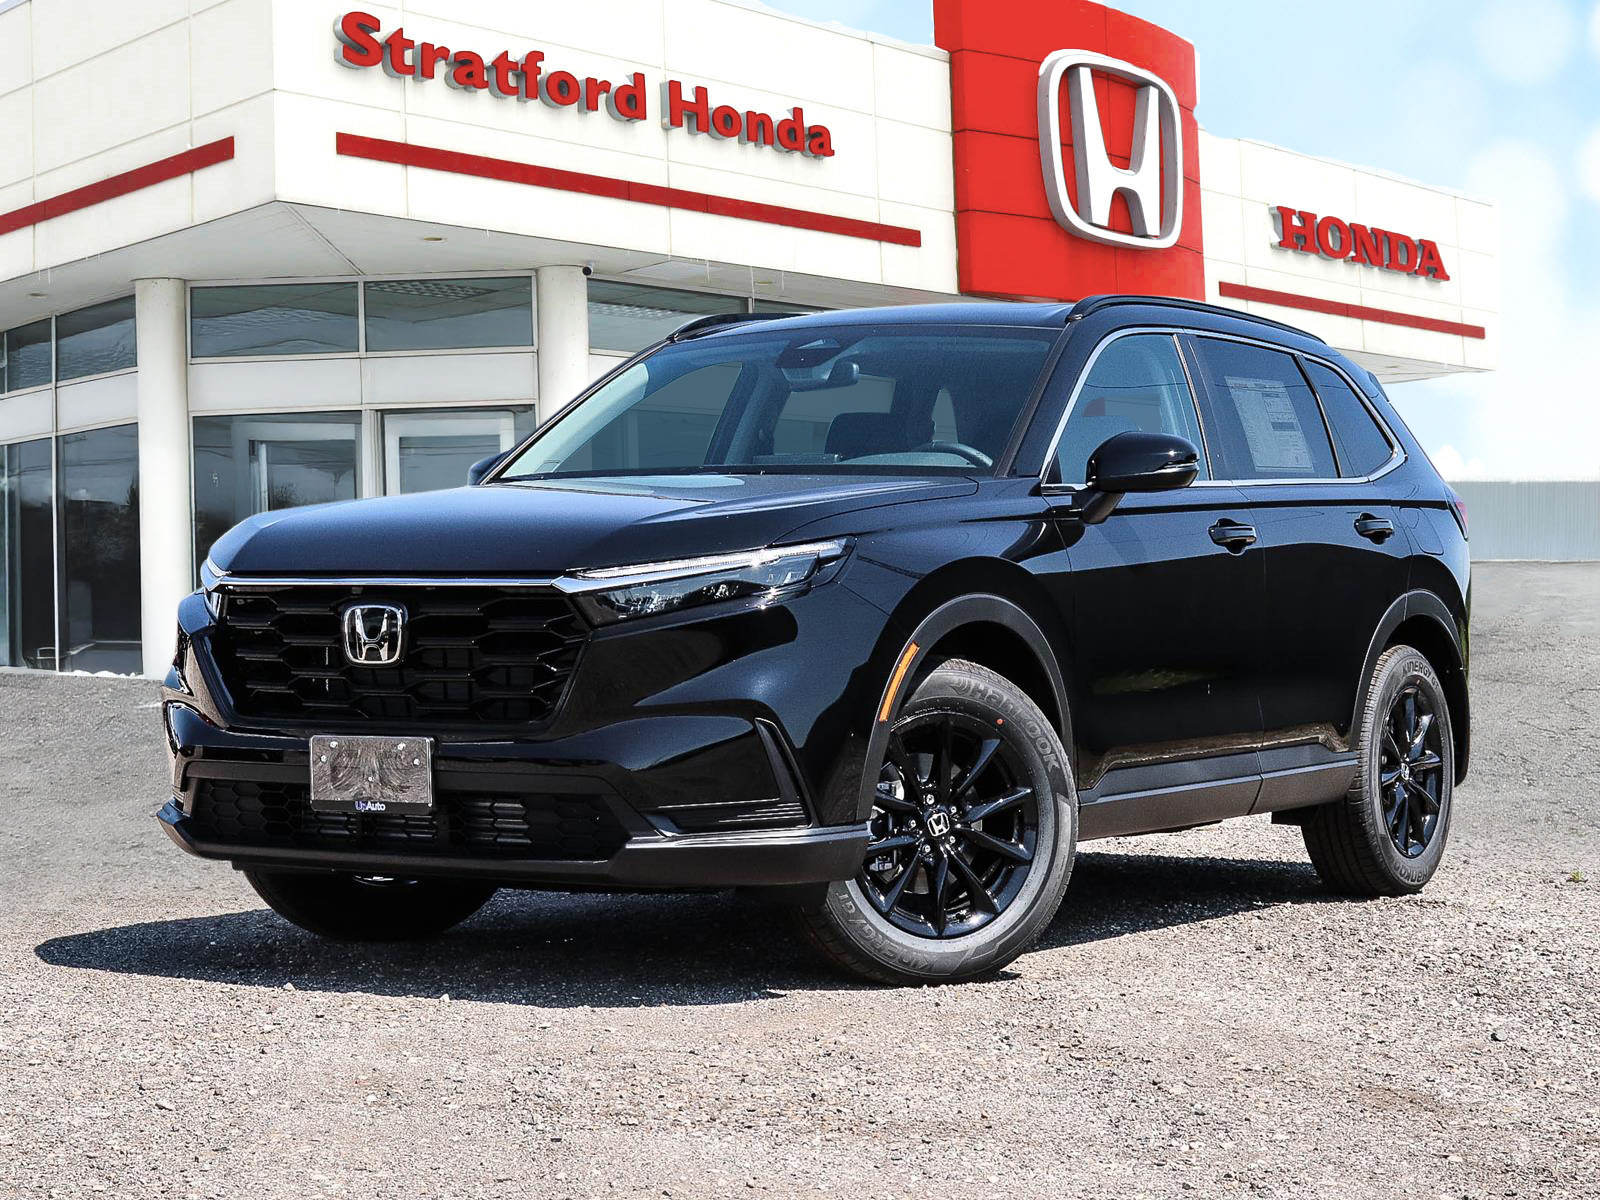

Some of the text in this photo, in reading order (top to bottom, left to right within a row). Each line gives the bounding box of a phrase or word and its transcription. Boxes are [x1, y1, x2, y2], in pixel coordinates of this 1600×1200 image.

[335, 10, 835, 159] Stratford Honda
[1269, 205, 1450, 282] HONDA
[355, 800, 386, 813] UpAuto
